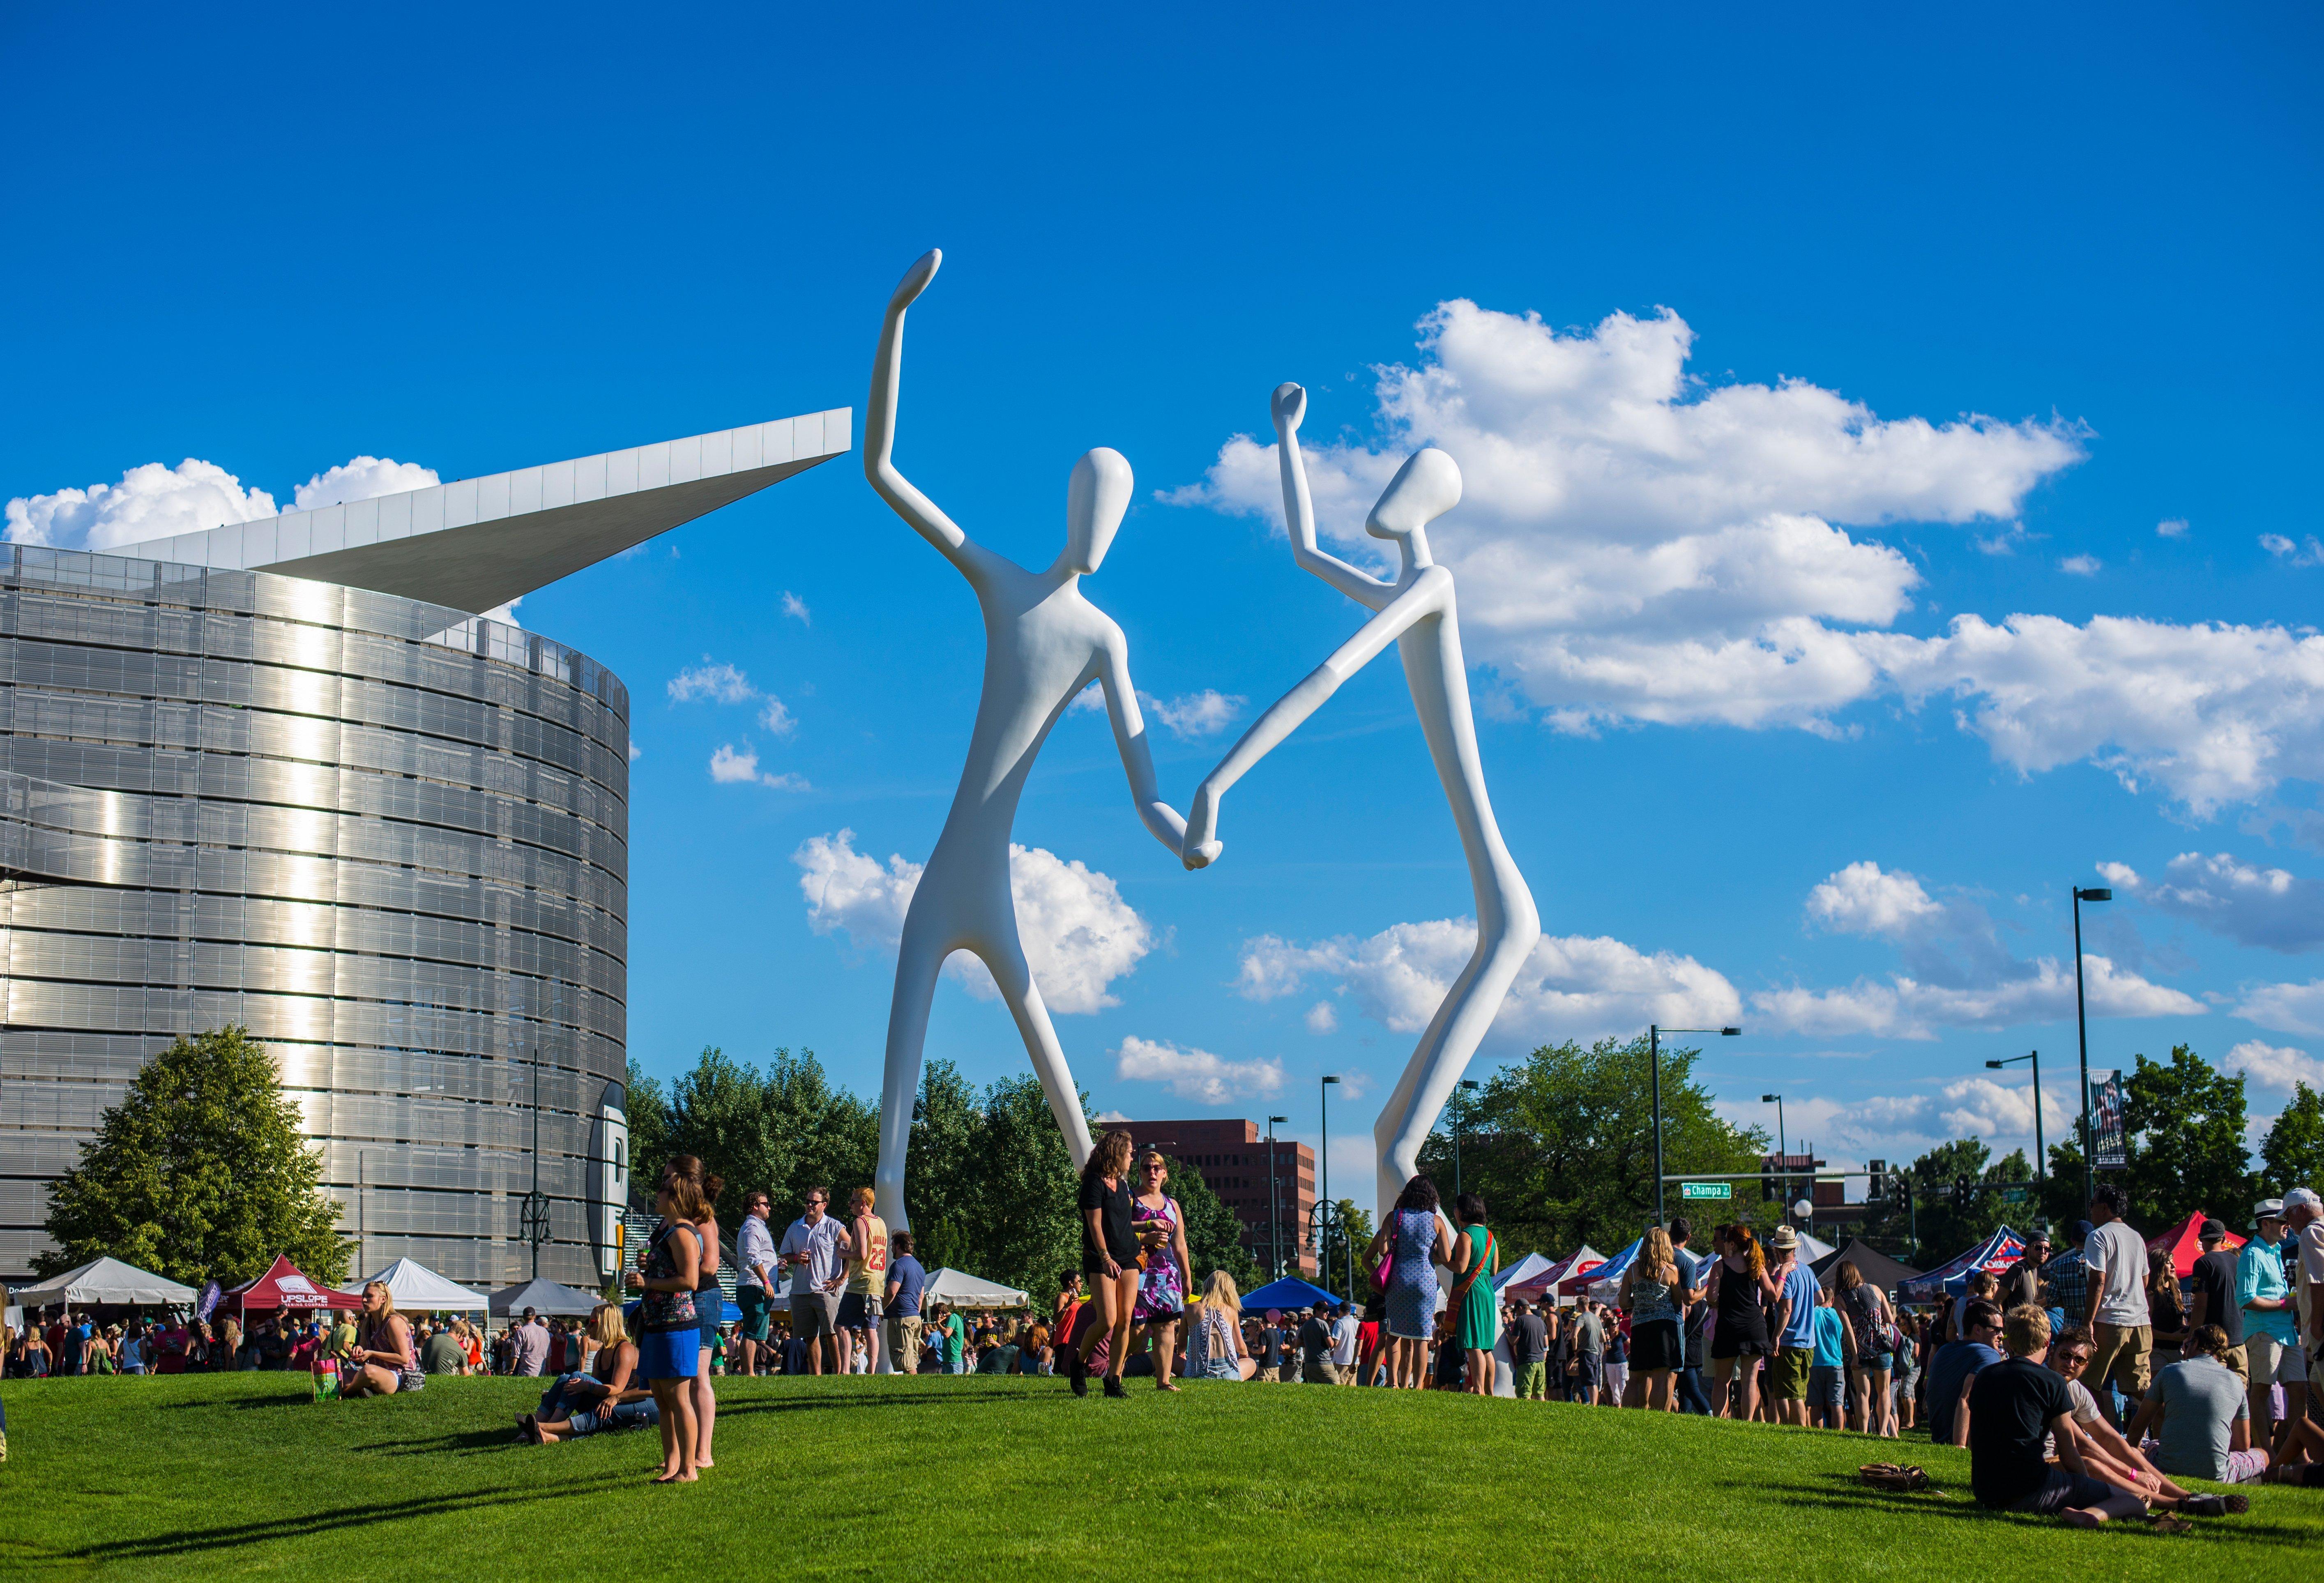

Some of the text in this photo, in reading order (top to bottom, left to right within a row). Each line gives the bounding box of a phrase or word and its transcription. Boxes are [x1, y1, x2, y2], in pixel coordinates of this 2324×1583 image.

[1692, 1185, 1721, 1197] Champa
[869, 1248, 886, 1271] 23
[281, 1295, 328, 1303] UPSLOPE
